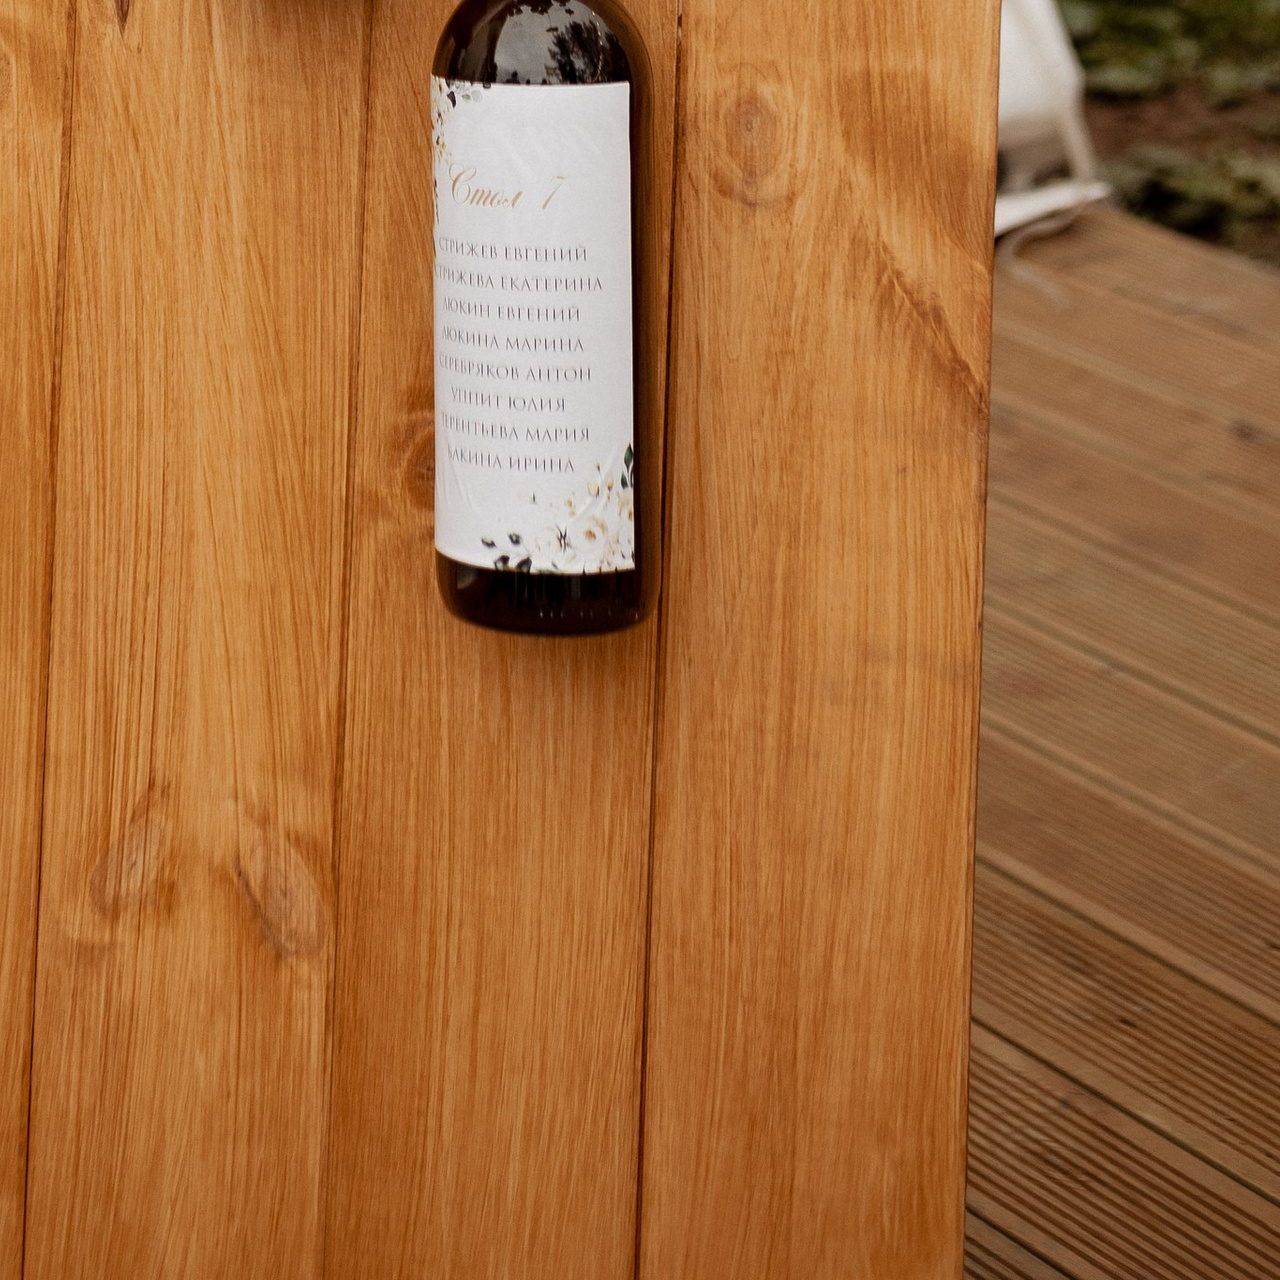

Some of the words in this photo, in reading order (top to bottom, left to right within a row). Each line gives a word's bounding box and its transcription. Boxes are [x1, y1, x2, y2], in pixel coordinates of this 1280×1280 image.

[448, 163, 523, 209] Стол
[541, 175, 566, 211] 7
[438, 237, 498, 260] СТРИЖЕВ
[504, 243, 587, 262] ЕВГЕНИЙ
[434, 264, 495, 289] СТРИЖЕВА
[501, 276, 603, 292] ЕКАТЕРИНА
[498, 304, 580, 322] ЕВГЕНИЙ
[505, 336, 584, 352] МАРИНА
[439, 353, 519, 380] СЕРЕБРЯКОВ
[526, 367, 591, 382] АНТОН
[508, 397, 566, 412] ЮЛИЯ
[525, 427, 589, 442] МАРИЯ
[509, 456, 575, 473] ИРИНА
